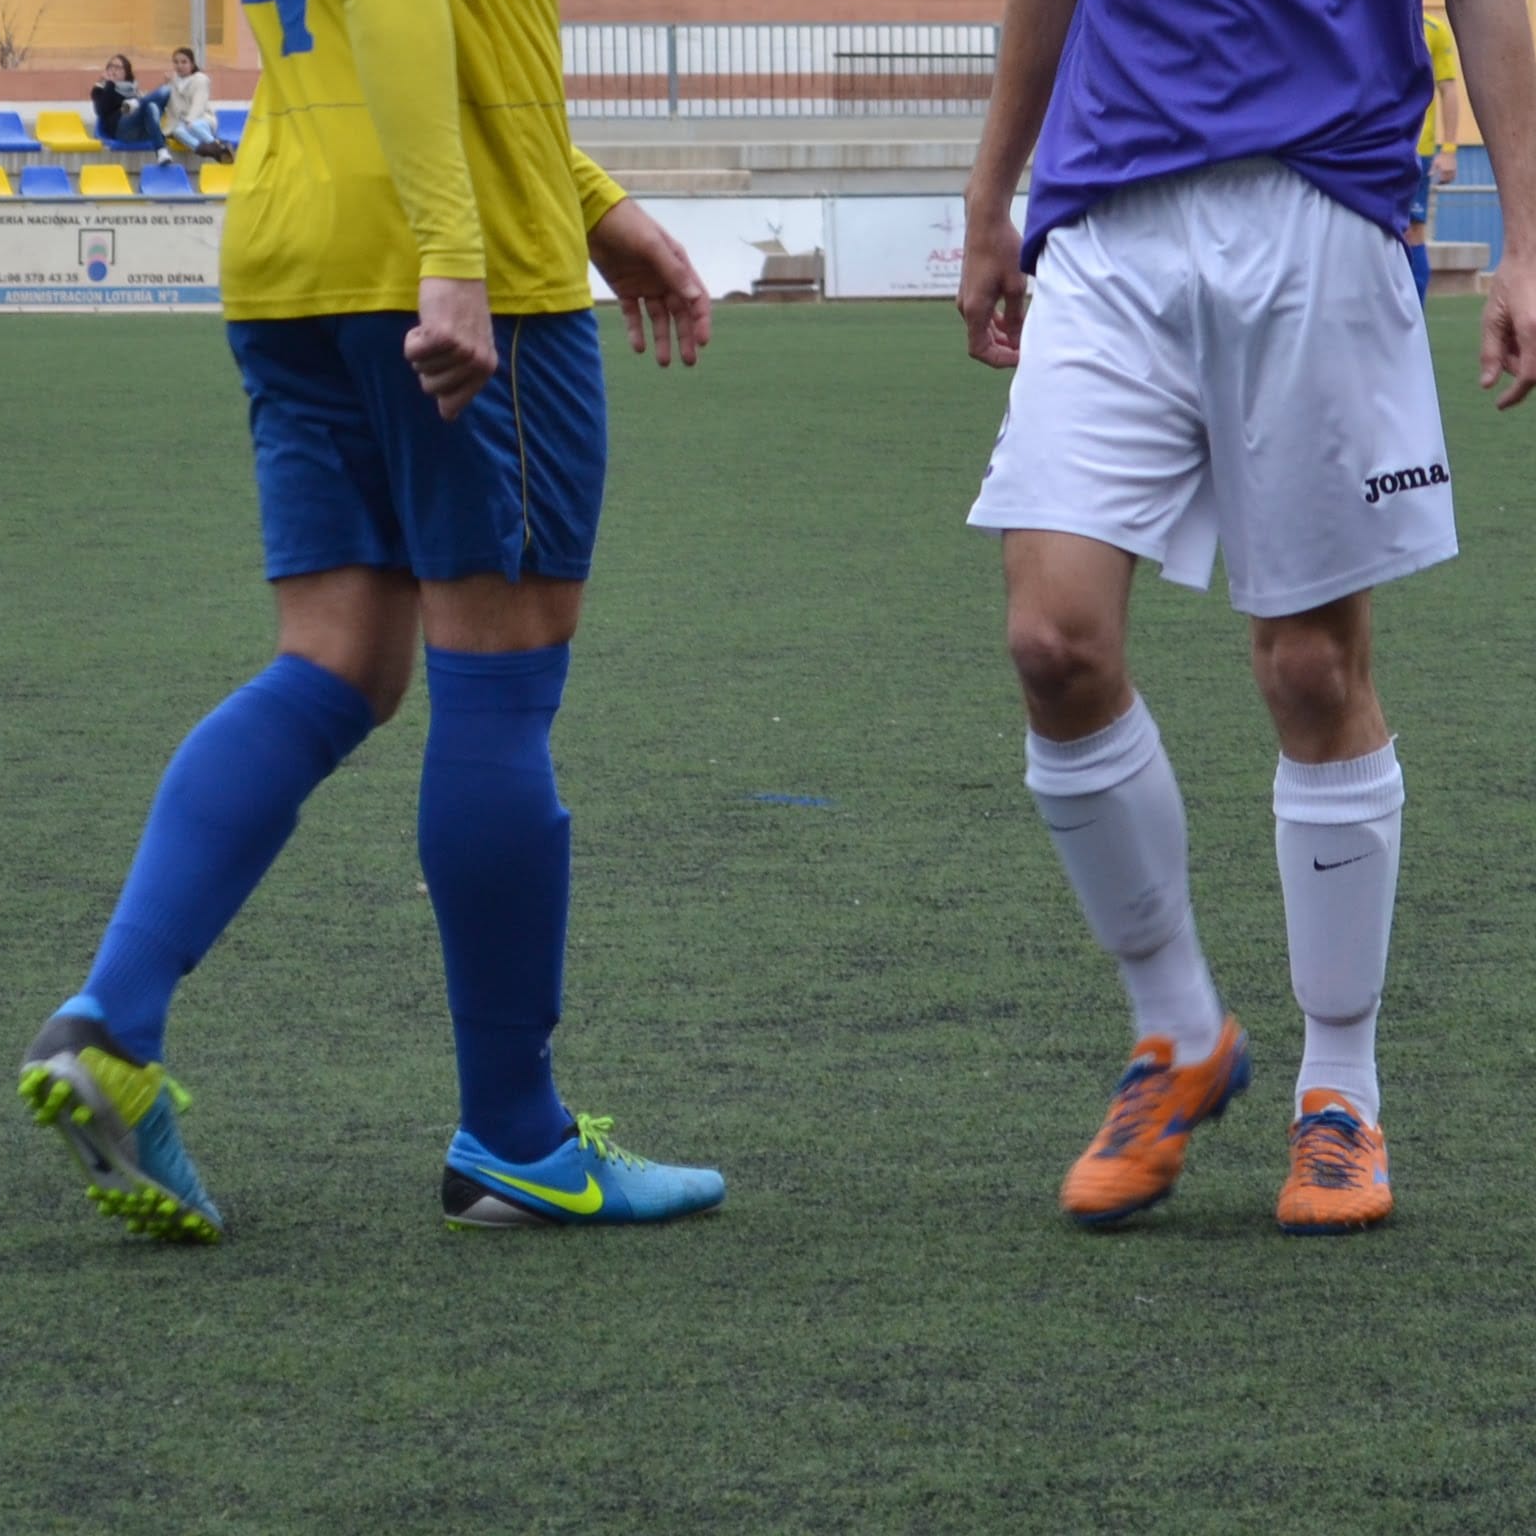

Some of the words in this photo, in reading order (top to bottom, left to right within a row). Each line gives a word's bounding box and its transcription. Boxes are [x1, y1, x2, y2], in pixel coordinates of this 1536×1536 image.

[27, 215, 81, 225] NACIONAL
[83, 215, 90, 224] Y
[95, 215, 148, 225] APUESTAS
[150, 215, 171, 225] DEL
[173, 215, 214, 225] ESTADO
[1365, 463, 1449, 504] Joma
